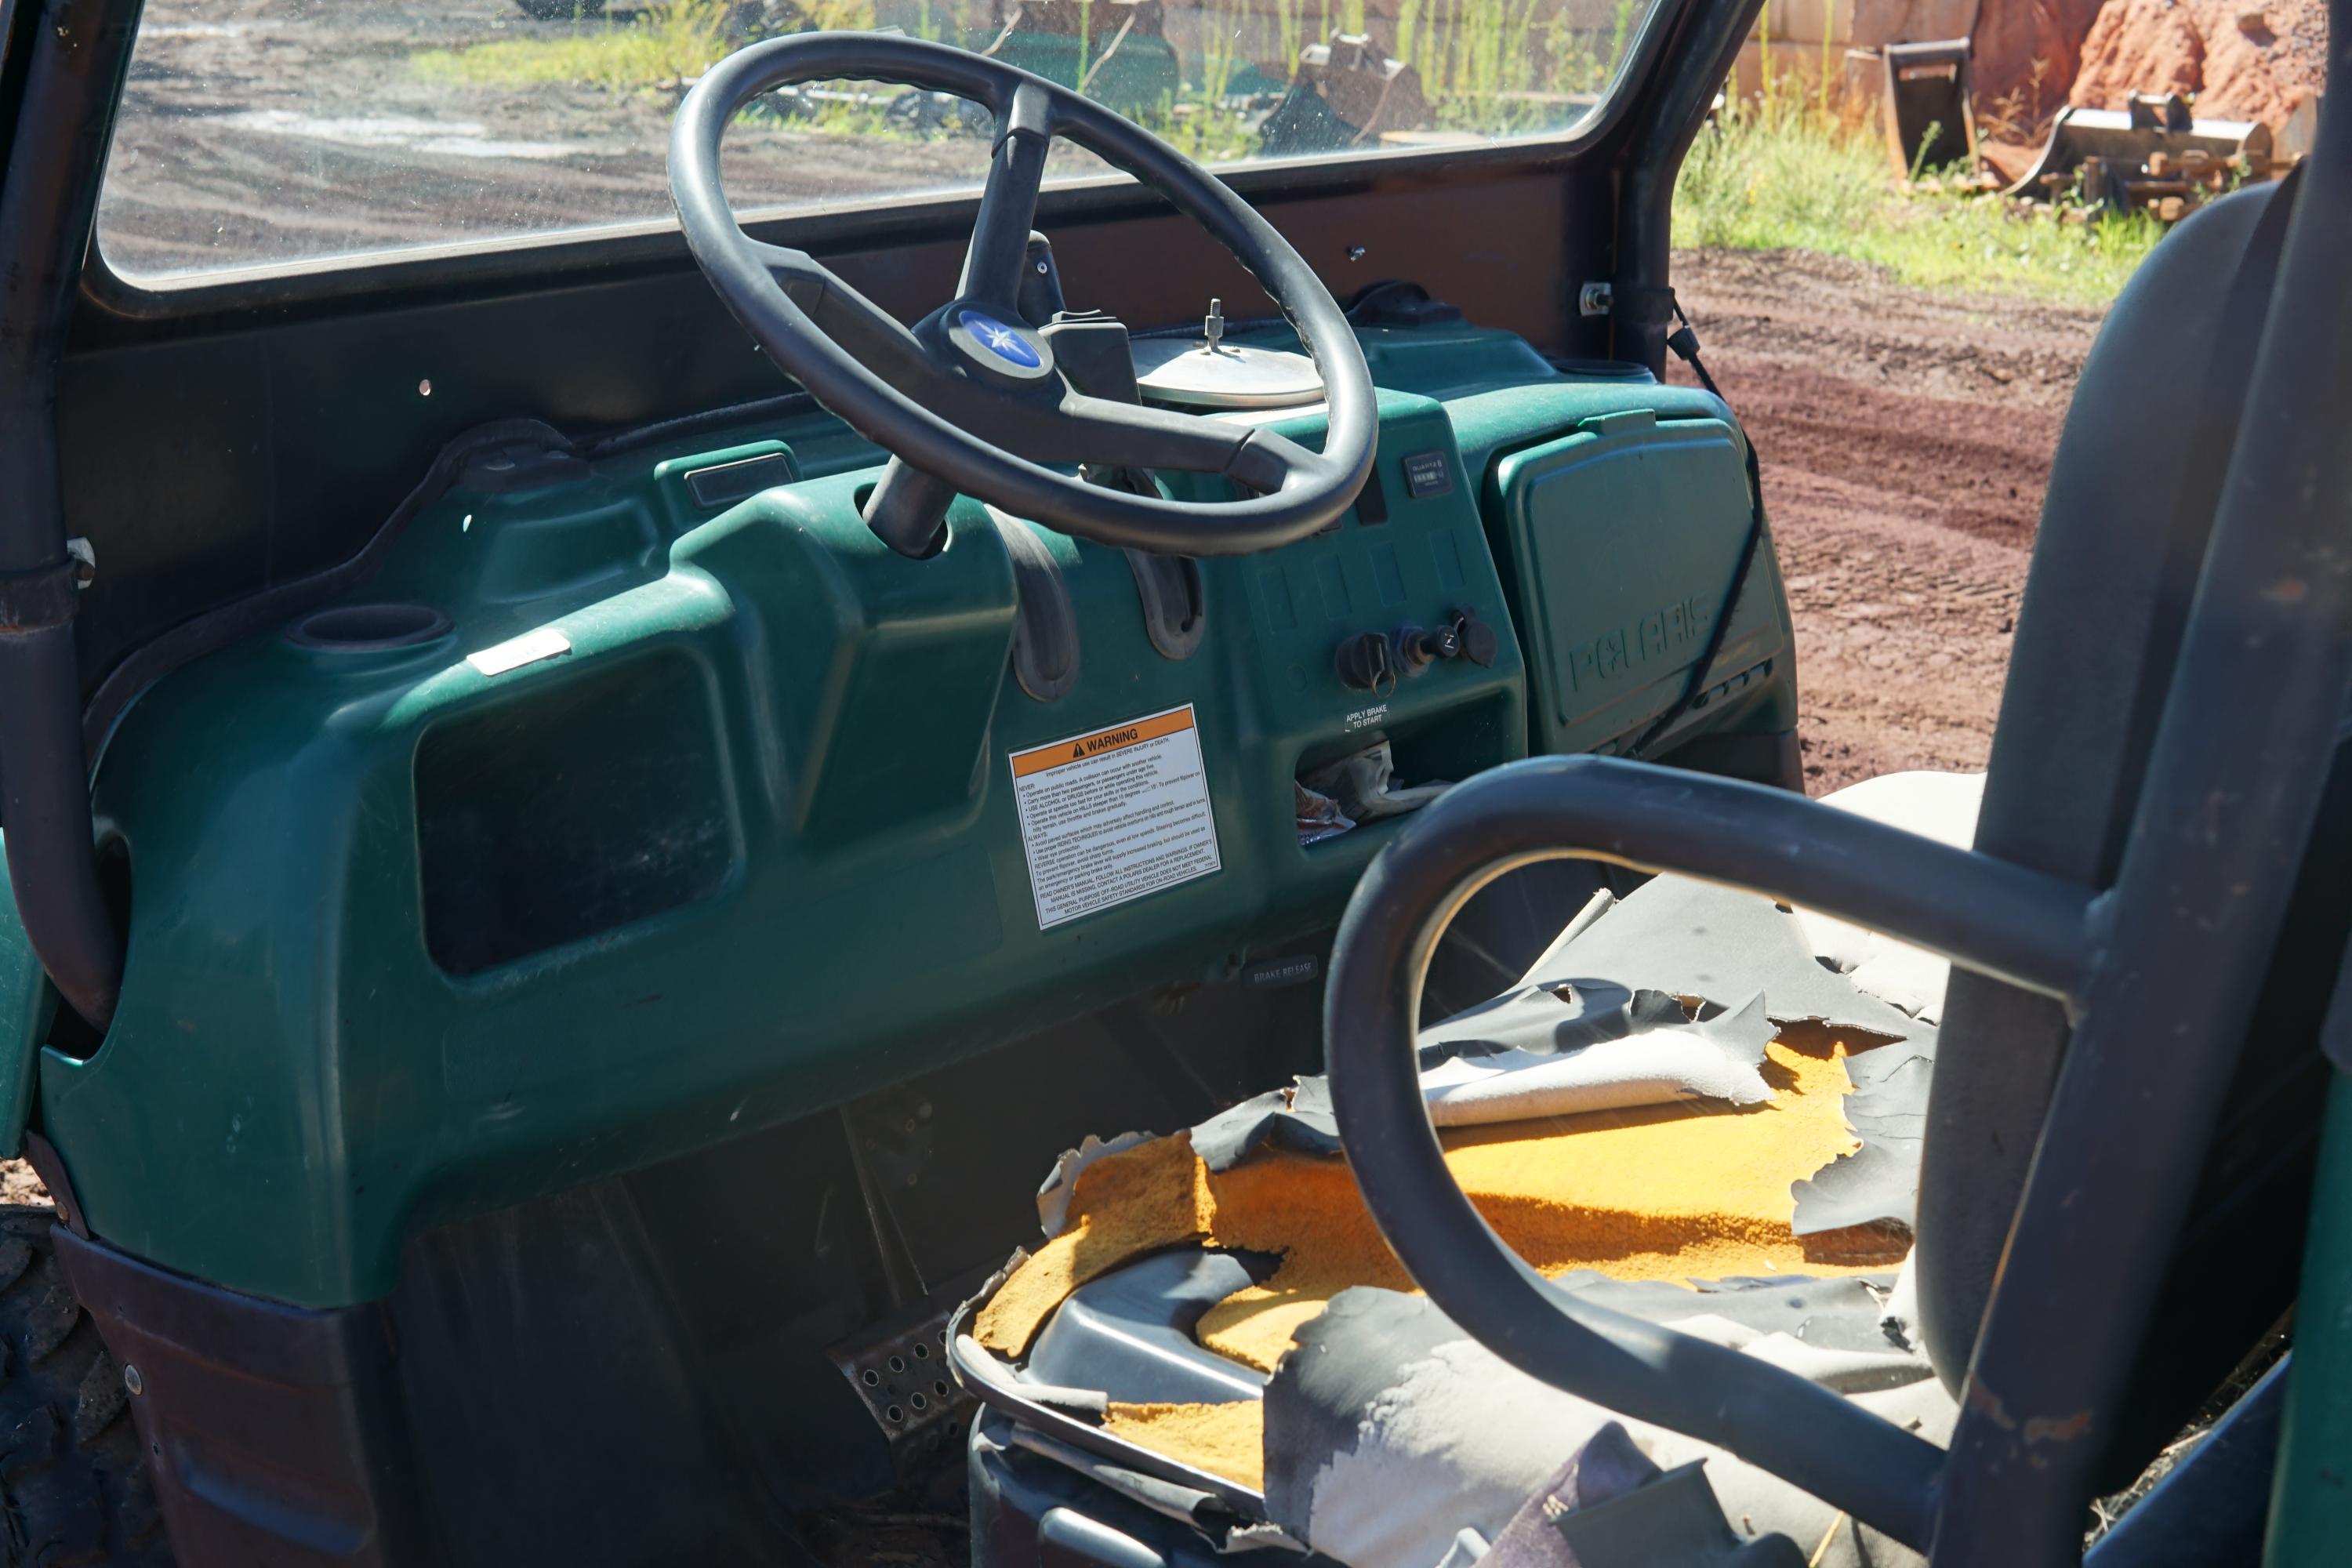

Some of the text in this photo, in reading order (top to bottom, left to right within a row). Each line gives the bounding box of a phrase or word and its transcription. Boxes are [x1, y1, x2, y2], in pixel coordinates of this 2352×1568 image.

[1346, 704, 1388, 723] APPLY BRAKE
[1353, 714, 1382, 729] TO START
[1087, 728, 1138, 753] WARNING
[1102, 773, 1125, 784] passengers
[1039, 798, 1062, 809] ALCOHOL
[1067, 791, 1083, 800] DRUGS
[1116, 777, 1135, 786] operating
[1040, 891, 1052, 899] READ
[1095, 871, 1114, 881] FOLLOW
[1123, 858, 1155, 873] INSTRUCTIONS
[1051, 892, 1070, 903] MANUAL
[1097, 877, 1119, 888] CONTACT
[1123, 869, 1142, 880] POLARIS
[1142, 863, 1160, 873] DEALER
[1057, 898, 1078, 910] GENERAL
[1079, 891, 1101, 903] PURPOSE
[1101, 884, 1124, 895] OFF-ROAD
[1124, 878, 1141, 888] UTILITY
[1142, 873, 1160, 882] VEHICLE
[1160, 868, 1172, 877] DOES
[1194, 855, 1212, 865] FEDERAL
[1064, 904, 1082, 914] MOTOR
[1082, 898, 1102, 909] VEHICLE
[1102, 892, 1118, 902] SAFETY
[1119, 883, 1145, 896] STANDARDS
[1156, 873, 1176, 884] ON-ROAD
[1254, 962, 1312, 985] BRAKE RELEASE
